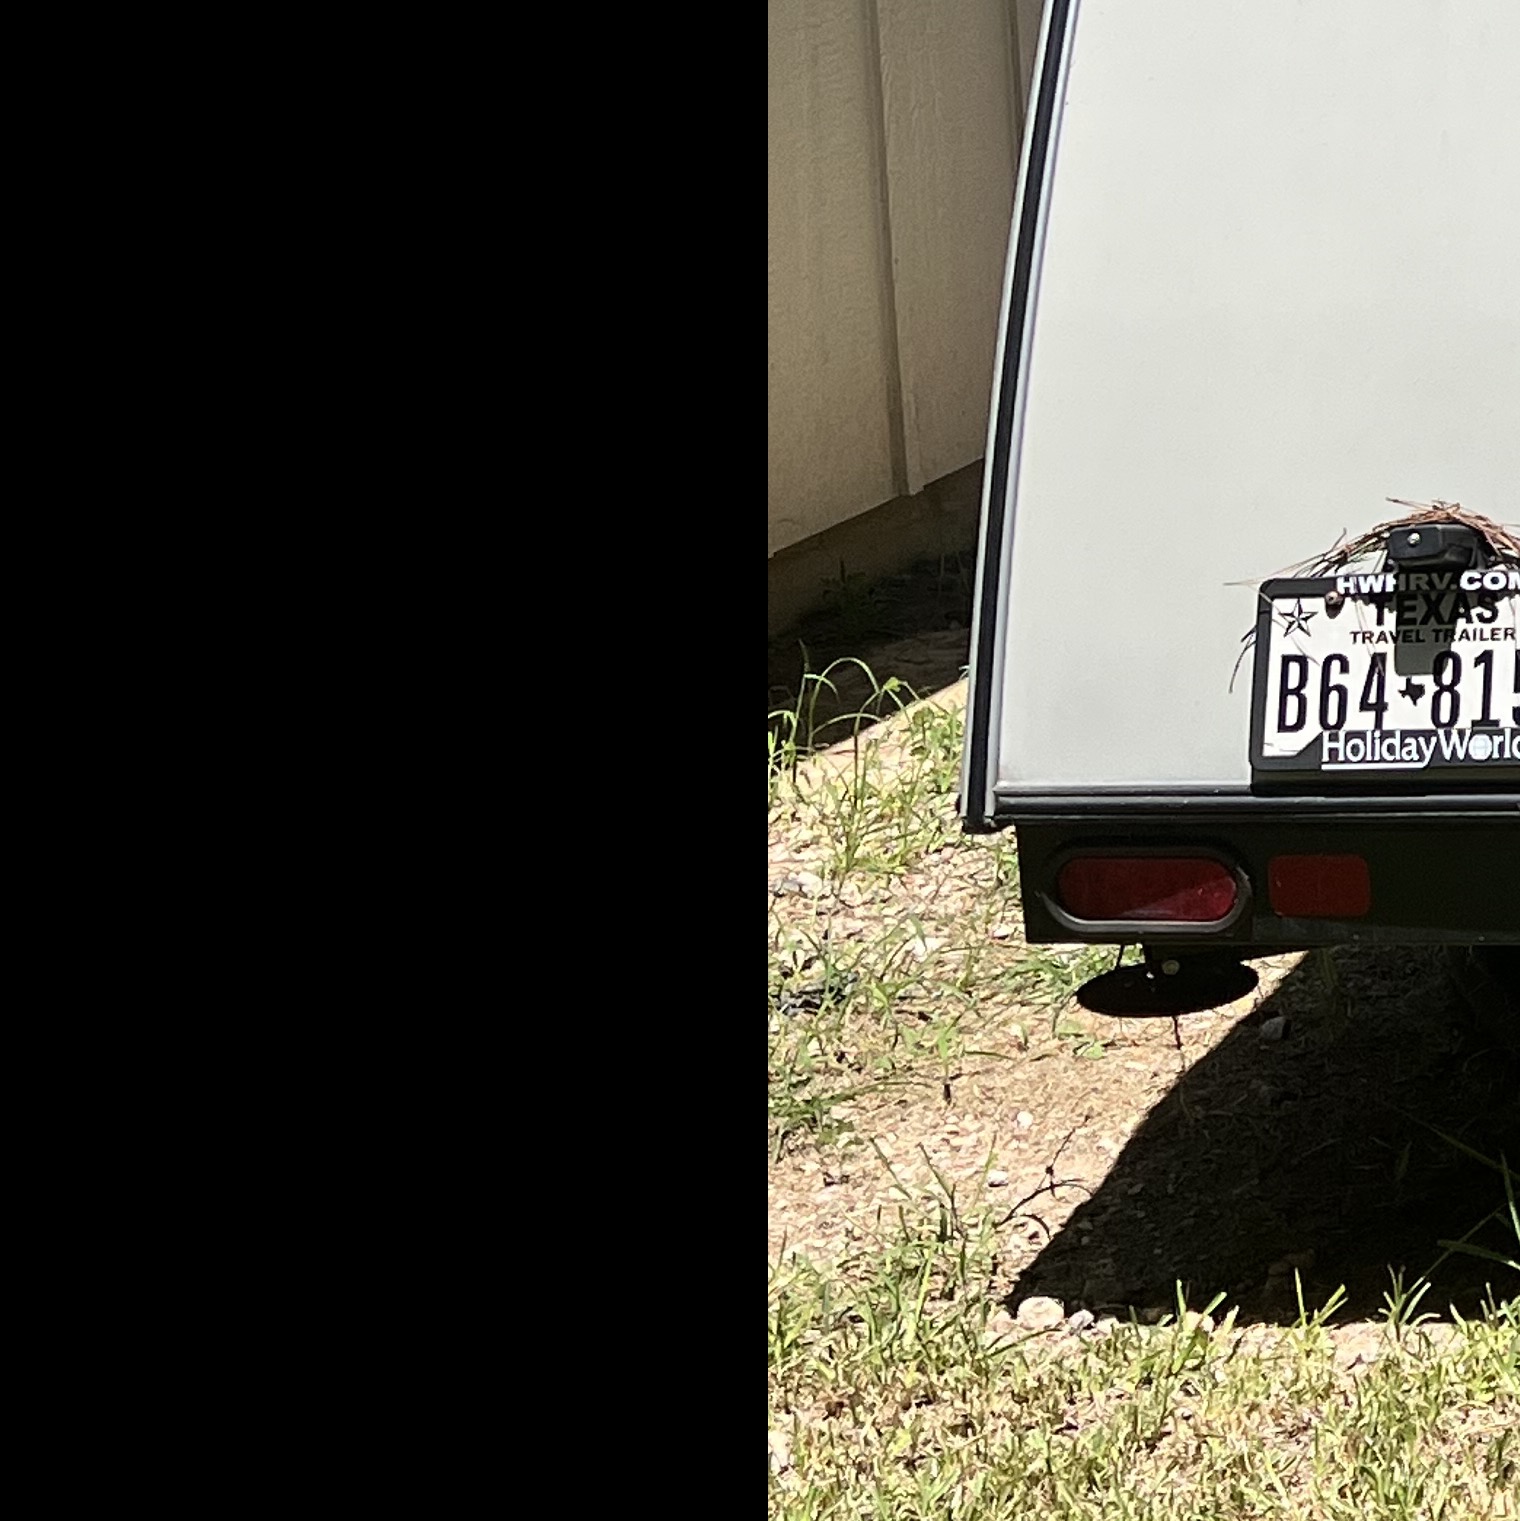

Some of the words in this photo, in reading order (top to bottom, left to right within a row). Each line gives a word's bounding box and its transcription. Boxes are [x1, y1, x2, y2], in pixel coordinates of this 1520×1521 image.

[1374, 592, 1499, 627] TEXAS
[1350, 627, 1427, 645] TRAVEL
[1434, 626, 1517, 644] TRAILER
[1276, 651, 1389, 734] B64
